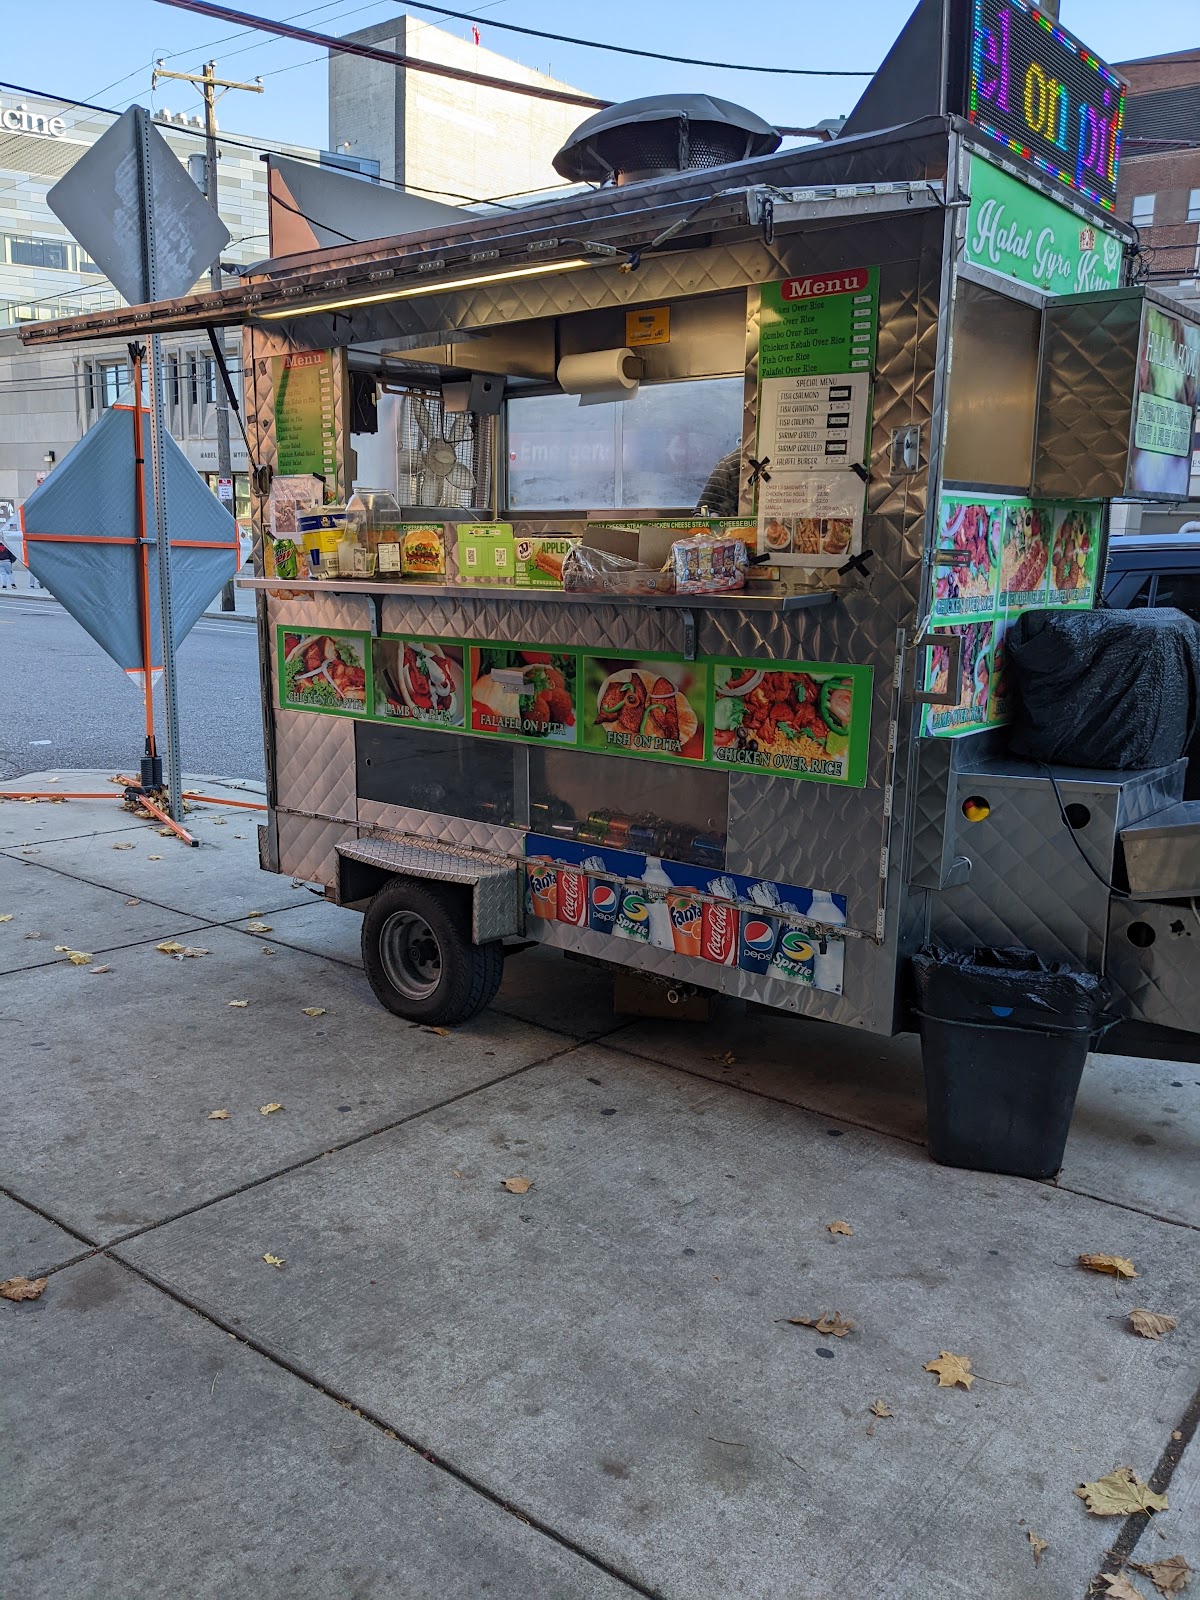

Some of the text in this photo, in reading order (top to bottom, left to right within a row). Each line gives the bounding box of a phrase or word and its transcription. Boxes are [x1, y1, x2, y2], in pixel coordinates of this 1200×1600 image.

[1024, 61, 1069, 151] on
[973, 199, 1032, 263] Halal
[1032, 227, 1071, 279] Gyro
[789, 276, 859, 298] Menu
[791, 304, 808, 313] Over
[809, 302, 824, 310] Rice
[782, 317, 798, 326] Over
[800, 315, 815, 324] Rice
[763, 327, 818, 341] Combo Over Rice
[762, 343, 789, 353] Chicken
[790, 339, 811, 349] Kebab
[812, 338, 829, 347] Over
[830, 336, 845, 344] Rice
[286, 354, 322, 368] Menu
[762, 353, 810, 365] Fish Over Rice
[762, 364, 818, 377] Falafel Over Rice
[796, 377, 838, 387] SPECIAL MENU
[541, 541, 564, 554] APPLE
[288, 692, 365, 711] CHICKEN ON PITA
[384, 703, 452, 722] LAMB ON PITA
[481, 715, 566, 735] FALAFEL ON PITA
[607, 731, 682, 752] FISH ON PITA
[716, 746, 842, 776] CHICKEN OVER RICE
[616, 913, 649, 935] Sprite
[773, 952, 813, 977] Sprite
